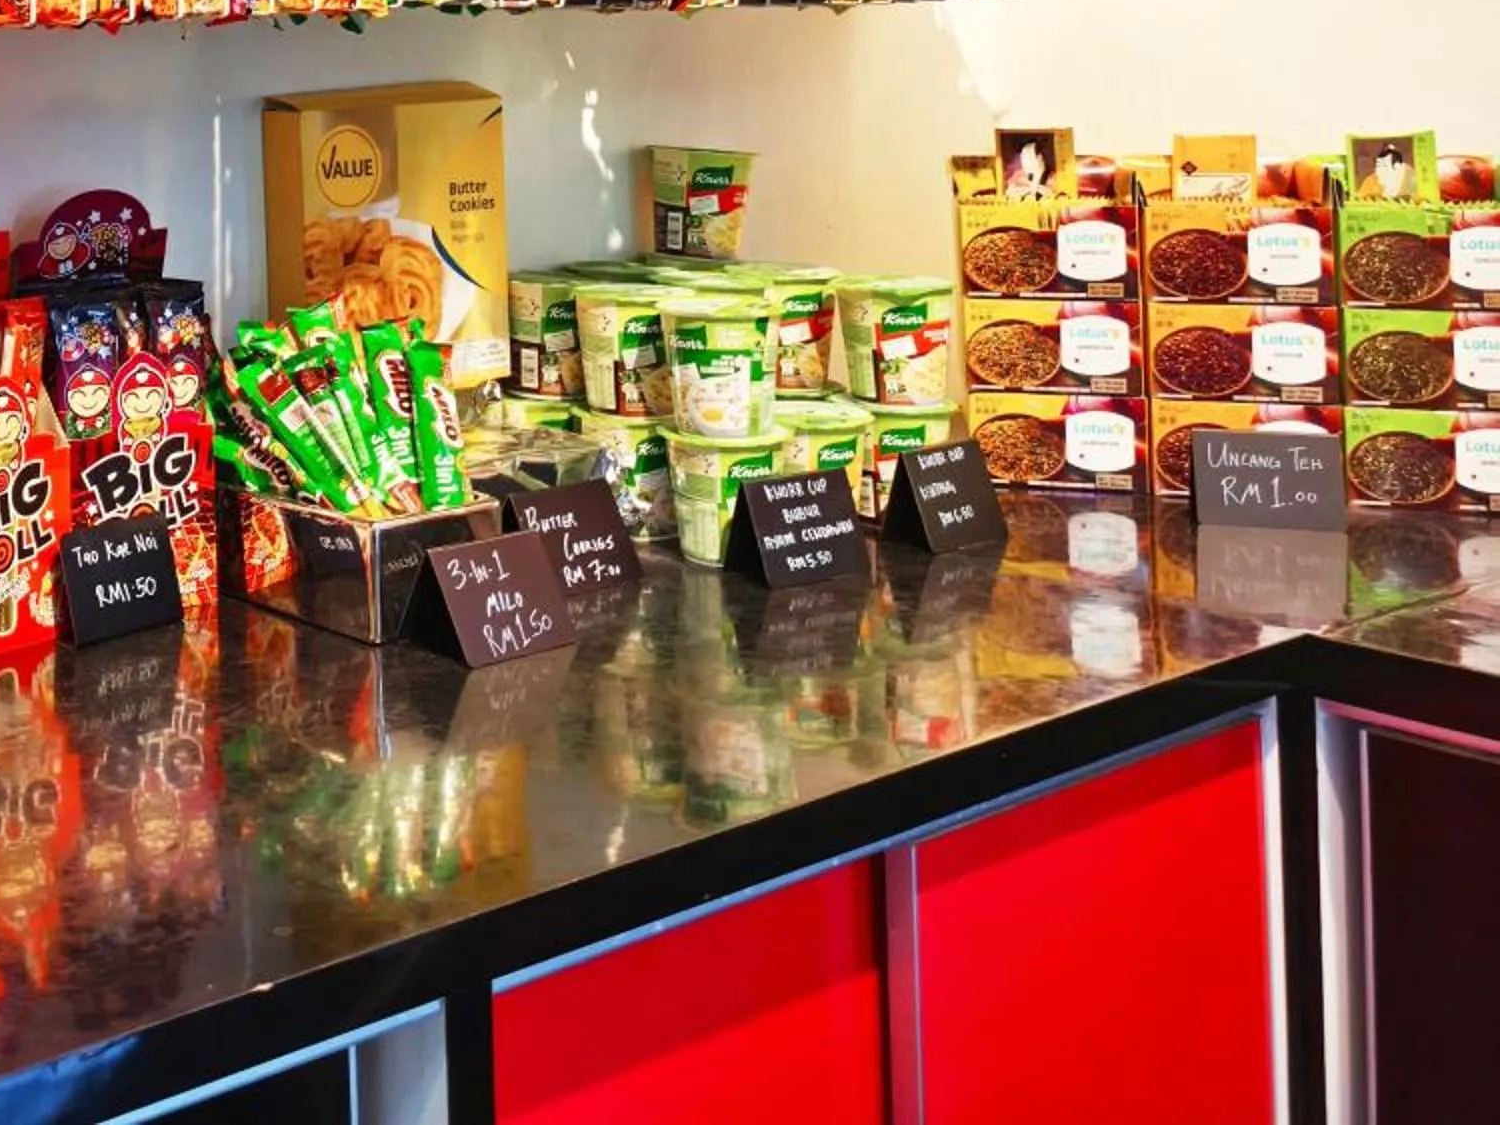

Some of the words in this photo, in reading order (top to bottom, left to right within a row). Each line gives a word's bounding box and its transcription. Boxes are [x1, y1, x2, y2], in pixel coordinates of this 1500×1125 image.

[321, 144, 374, 180] VALUE
[449, 181, 487, 197] Butter
[449, 197, 496, 214] Cookies
[1207, 446, 1281, 470] UNCANG
[1289, 449, 1323, 470] TEH
[1221, 477, 1266, 507] RM
[1271, 478, 1317, 508] 1.00
[486, 592, 524, 617] MILO
